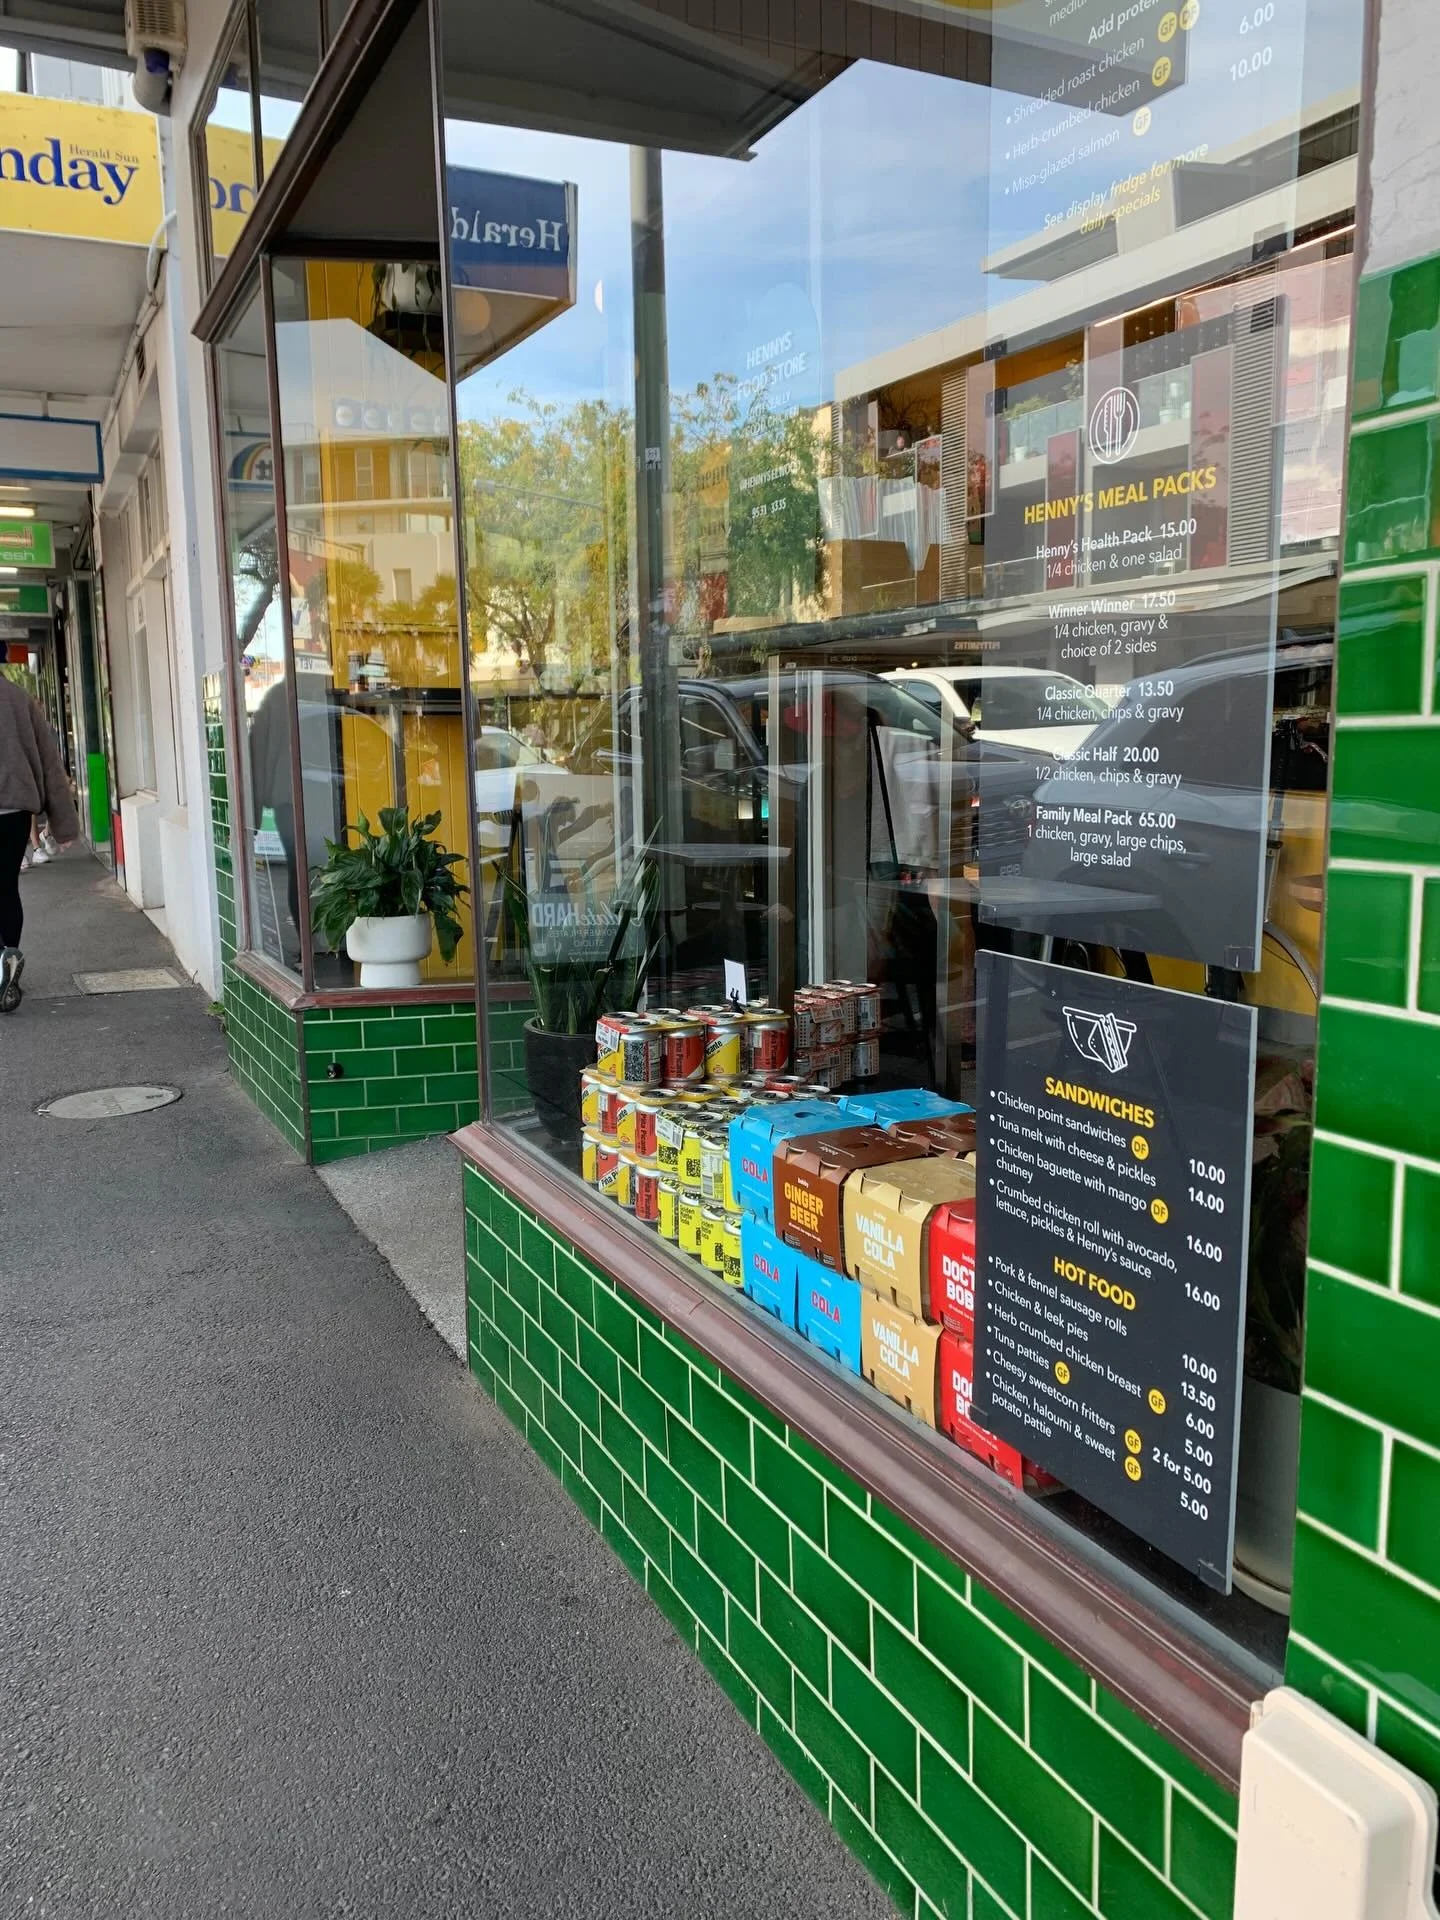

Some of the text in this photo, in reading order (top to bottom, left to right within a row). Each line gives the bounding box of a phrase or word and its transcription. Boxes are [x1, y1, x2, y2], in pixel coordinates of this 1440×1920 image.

[1088, 18, 1114, 44] Add
[1013, 3, 1274, 124] Shredded roast chicken 6.00
[1012, 46, 1272, 159] Herb-crumbed chicken 10.00
[69, 143, 140, 164] Herald Sun
[1012, 128, 1120, 193] Miso-glazed salmon
[1044, 144, 1208, 230] See display fridge for more
[1080, 188, 1160, 234] daily specials
[737, 352, 807, 401] FOOD STORE
[1024, 466, 1217, 525] HENNY'S MEAL PACKS
[1036, 518, 1197, 560] Henny's Health Pack 15.00
[1047, 544, 1182, 578] 1/4 chicken & one salad
[1048, 591, 1175, 619] Winner Winner 17.50
[1054, 614, 1168, 639] 1/4 chicken, gravy &
[1061, 639, 1157, 659] choice of 2 sides
[1045, 680, 1174, 700] Classic Quarter 13.50
[1037, 705, 1184, 723] 1/4 chicken, chips & gravy
[1093, 747, 1117, 761] Half
[1123, 747, 1159, 762] 20.00
[1035, 767, 1182, 789] 1/2 chicken, chips & gravy
[1036, 806, 1175, 828] Family Meal Pack 65.00
[1027, 825, 1187, 854] 1 chicken, gravy, large chips,
[1070, 849, 1131, 867] large salad
[1045, 1077, 1155, 1129] SANDWICHES
[998, 1090, 1226, 1185] Chicken point sandwiches 10.00
[743, 1158, 768, 1183] COLA
[996, 1157, 1033, 1184] chutney
[998, 1115, 1224, 1214] Tuna melt with cheese & pickles 14.00
[784, 1181, 824, 1217] GINGER
[789, 1202, 819, 1232] BEER
[997, 1139, 1223, 1263] Chicken baguette with mango 16.00
[856, 1211, 904, 1256] VANILLA
[863, 1237, 896, 1270] COLA
[996, 1199, 1152, 1278] lettuce, pickles & Henny's sauce
[996, 1179, 1220, 1311] Crumbed chicken roll with avocado, 16.00
[753, 1254, 779, 1281] COLA
[942, 1254, 976, 1291] DOCT
[1054, 1256, 1136, 1311] HOT FOOD
[811, 1290, 840, 1324] COLA
[995, 1257, 1217, 1384] Pork & fennel sausage rolls 10.00
[872, 1317, 919, 1367] VANILLA
[879, 1344, 910, 1380] COLA
[994, 1281, 1216, 1411] Chicken & leek pies 13.50
[994, 1304, 1017, 1327] Herb
[1019, 1321, 1063, 1353] crumbed
[1065, 1342, 1104, 1377] chicken
[1107, 1366, 1142, 1398] breast
[1186, 1413, 1215, 1440] 6.00
[991, 1393, 1022, 1420] potato
[1024, 1412, 1052, 1439] pattie
[994, 1327, 1213, 1467] Tuna patties 5.00
[993, 1351, 1212, 1494] Cheesy sweetcorn fritters 2 for 5.00
[992, 1374, 1031, 1410] Chicken,
[1033, 1398, 1072, 1433] haloumi
[1074, 1425, 1083, 1440] &
[1085, 1433, 1116, 1462] sweet
[1180, 1493, 1209, 1521] 5.00
